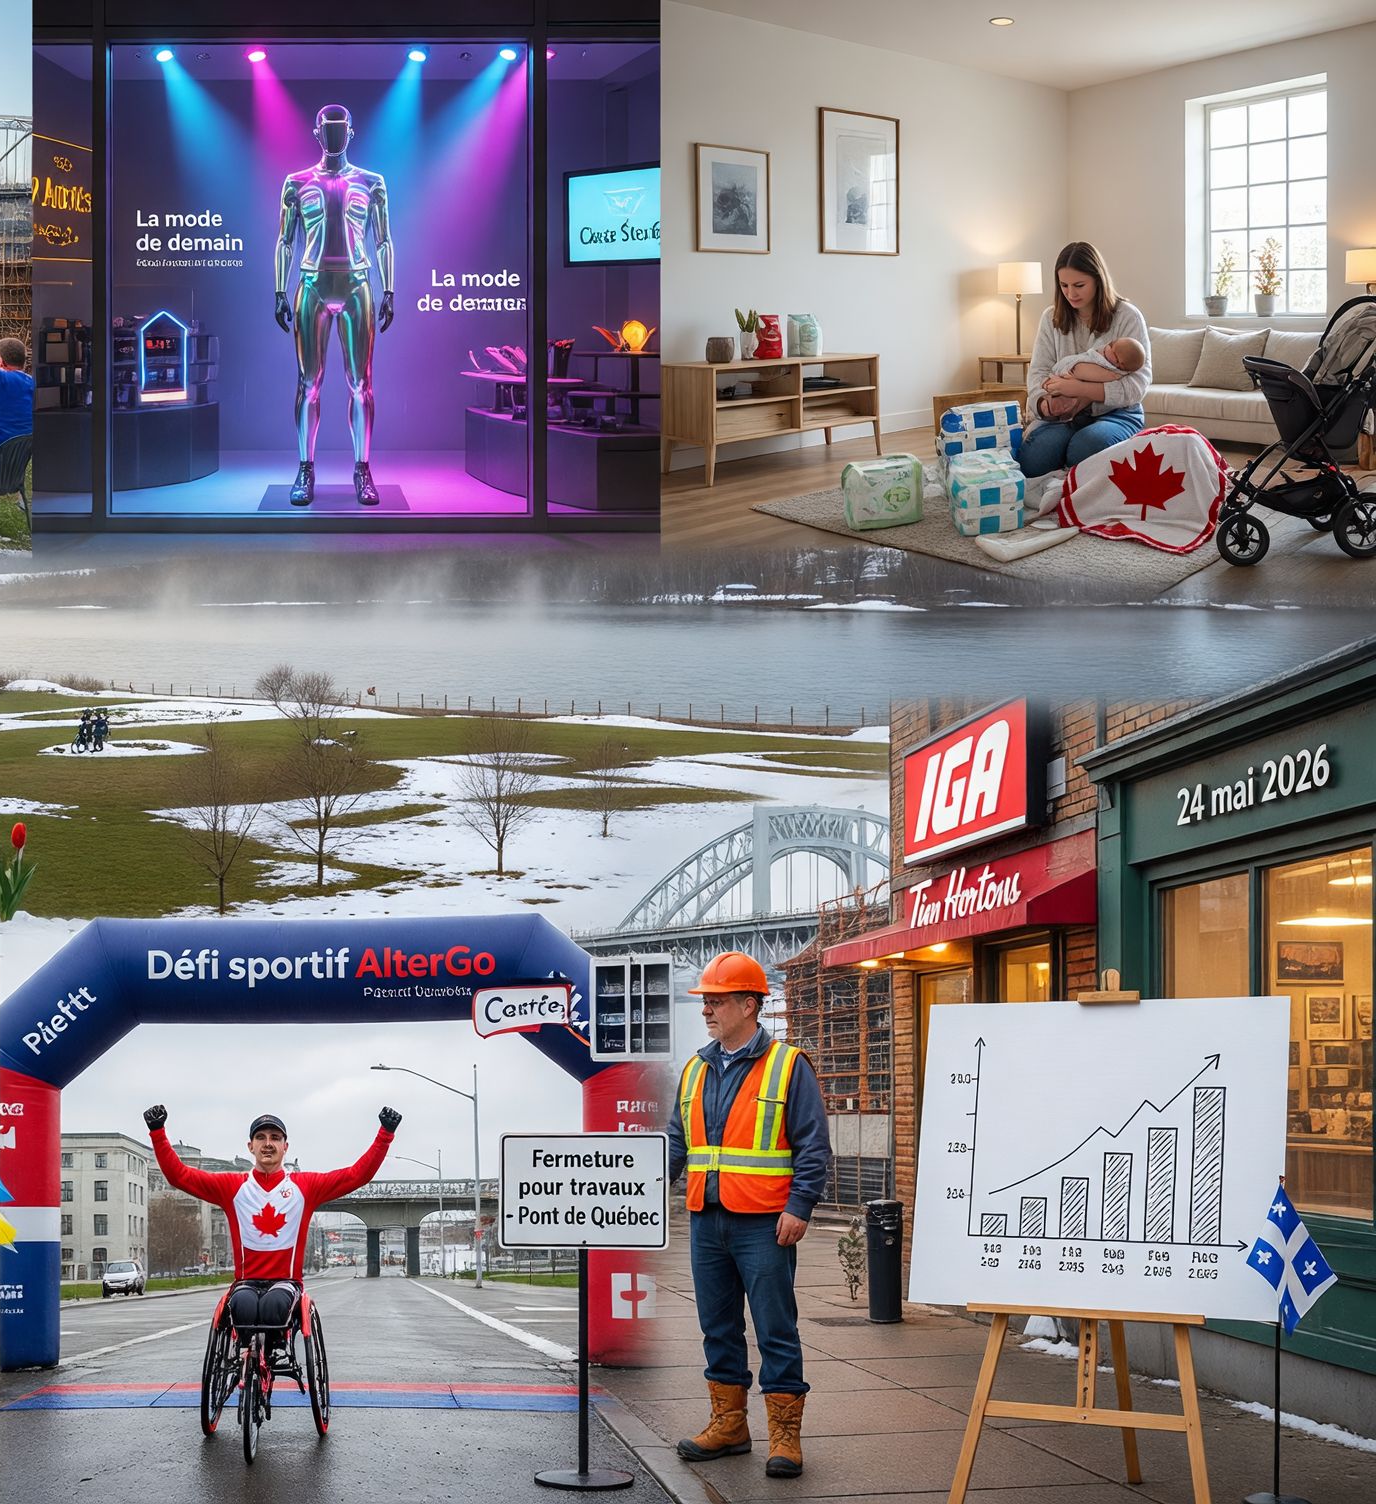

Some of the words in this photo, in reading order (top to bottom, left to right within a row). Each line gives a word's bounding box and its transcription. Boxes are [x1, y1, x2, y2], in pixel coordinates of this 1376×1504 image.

[136, 210, 159, 227] La
[165, 210, 223, 228] mode
[135, 233, 162, 251] de
[167, 233, 244, 251] demain
[431, 269, 455, 287] La
[461, 269, 521, 287] mode
[416, 294, 443, 312] de
[913, 719, 1011, 844] IGA
[1176, 783, 1206, 826] 24
[1210, 766, 1255, 817] mai
[1261, 743, 1331, 803] 2026
[943, 863, 1022, 922] Hortons
[147, 949, 220, 980] Défi
[227, 947, 350, 988] sportif
[354, 945, 497, 979] AlterGo
[532, 1149, 635, 1168] Fermeture
[519, 1181, 564, 1199] pour
[570, 1178, 646, 1196] travaux
[518, 1206, 560, 1225] Pont
[564, 1205, 586, 1225] de
[591, 1205, 660, 1229] Québec
